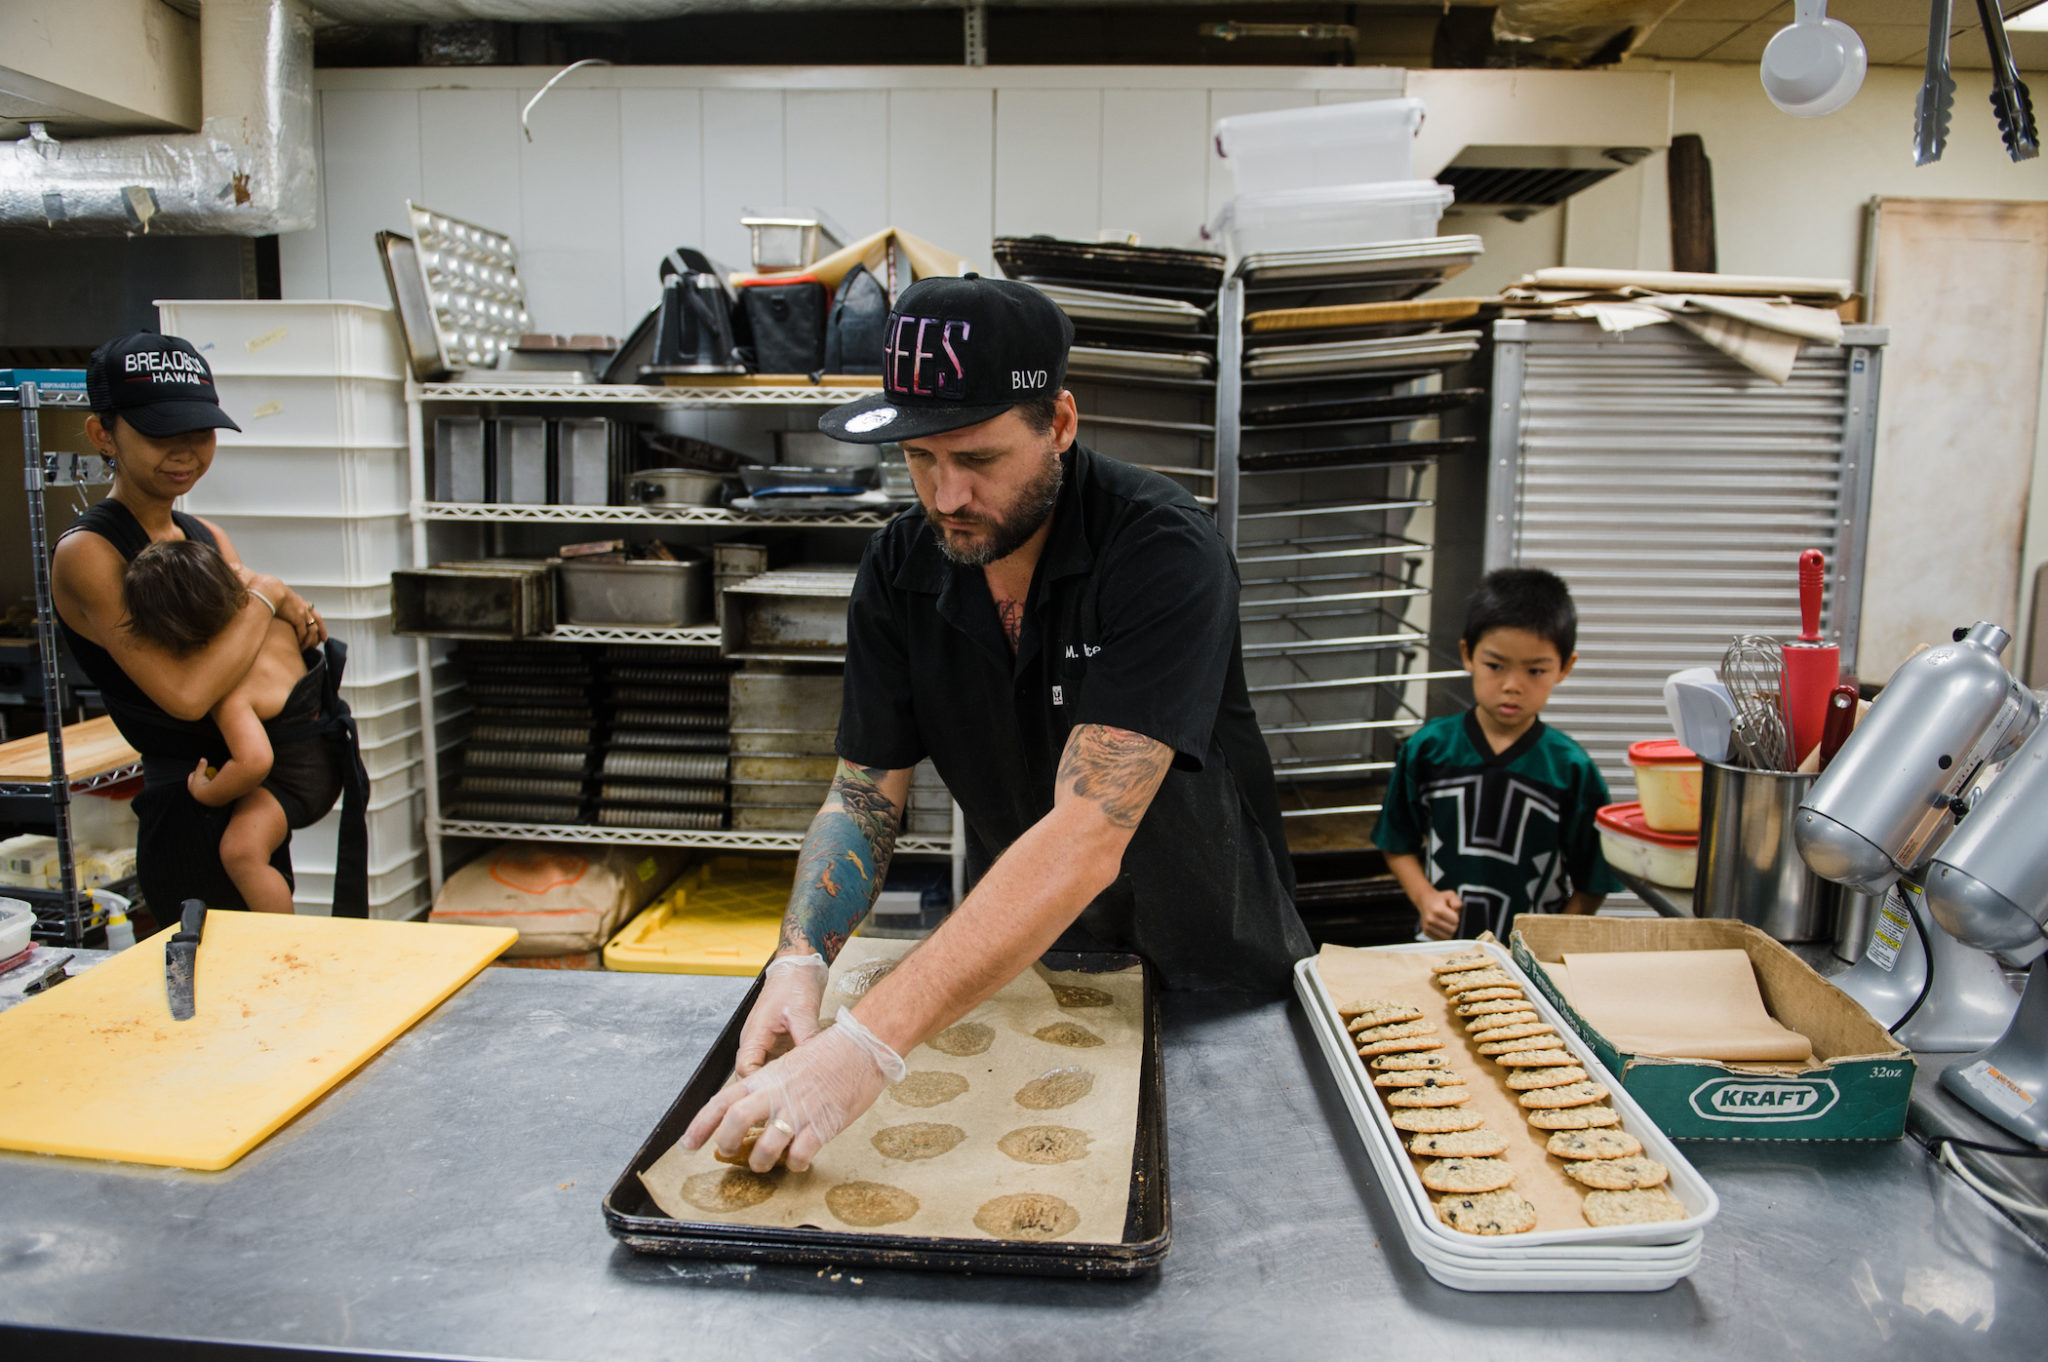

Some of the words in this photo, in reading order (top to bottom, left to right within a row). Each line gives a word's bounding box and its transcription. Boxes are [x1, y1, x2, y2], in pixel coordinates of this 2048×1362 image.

[1011, 370, 1048, 390] BLVD
[1065, 645, 1079, 659] M.
[1869, 1066, 1902, 1078] 32oz
[1720, 1089, 1812, 1107] KRAFT
